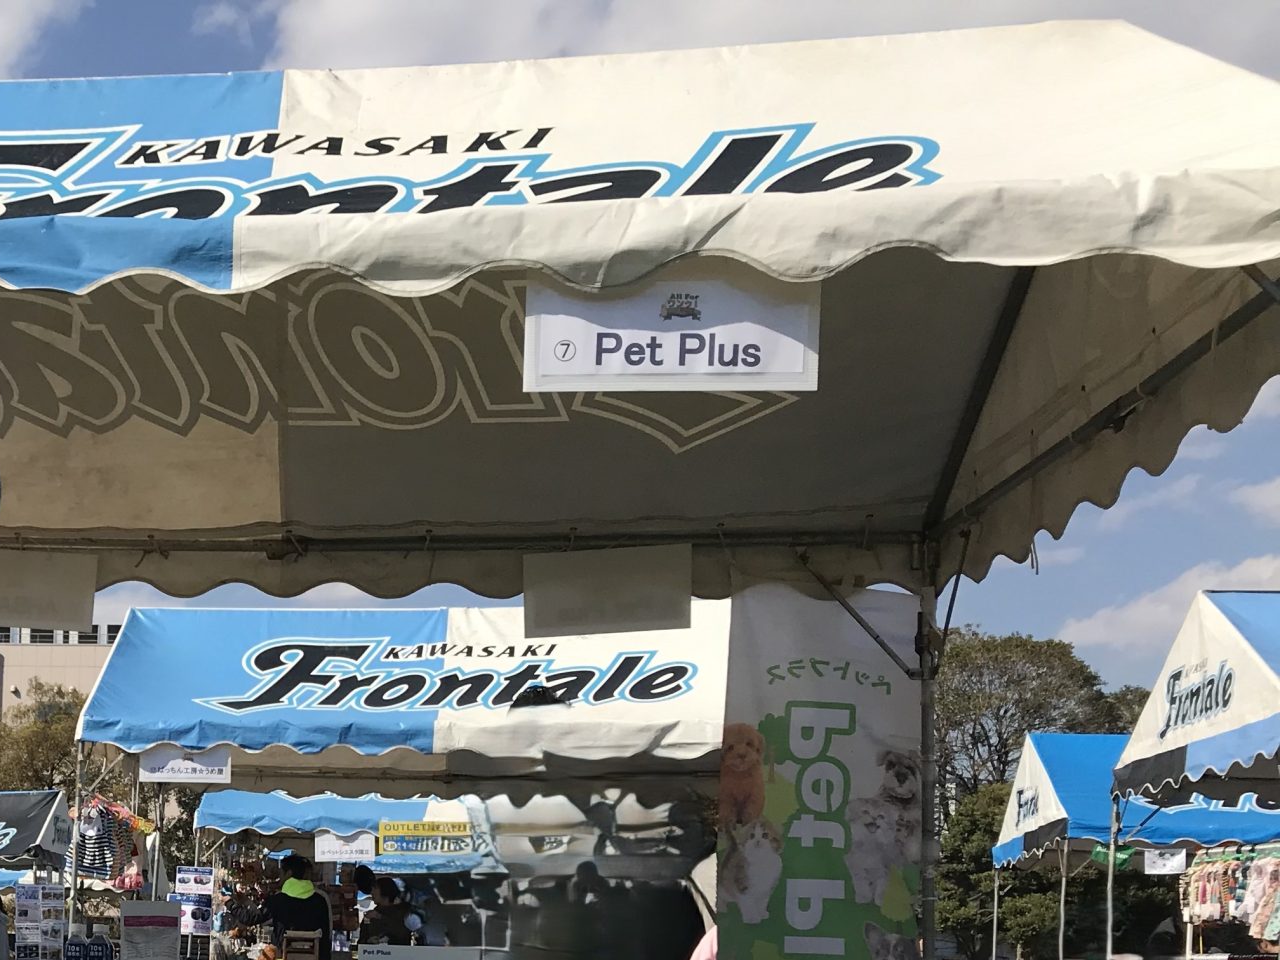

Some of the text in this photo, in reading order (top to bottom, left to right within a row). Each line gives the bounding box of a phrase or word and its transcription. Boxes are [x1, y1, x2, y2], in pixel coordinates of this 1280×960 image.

[117, 130, 554, 167] KAWASAKI
[595, 331, 664, 367] Pet
[678, 331, 762, 368] Plus
[383, 643, 558, 660] KAWASAKI
